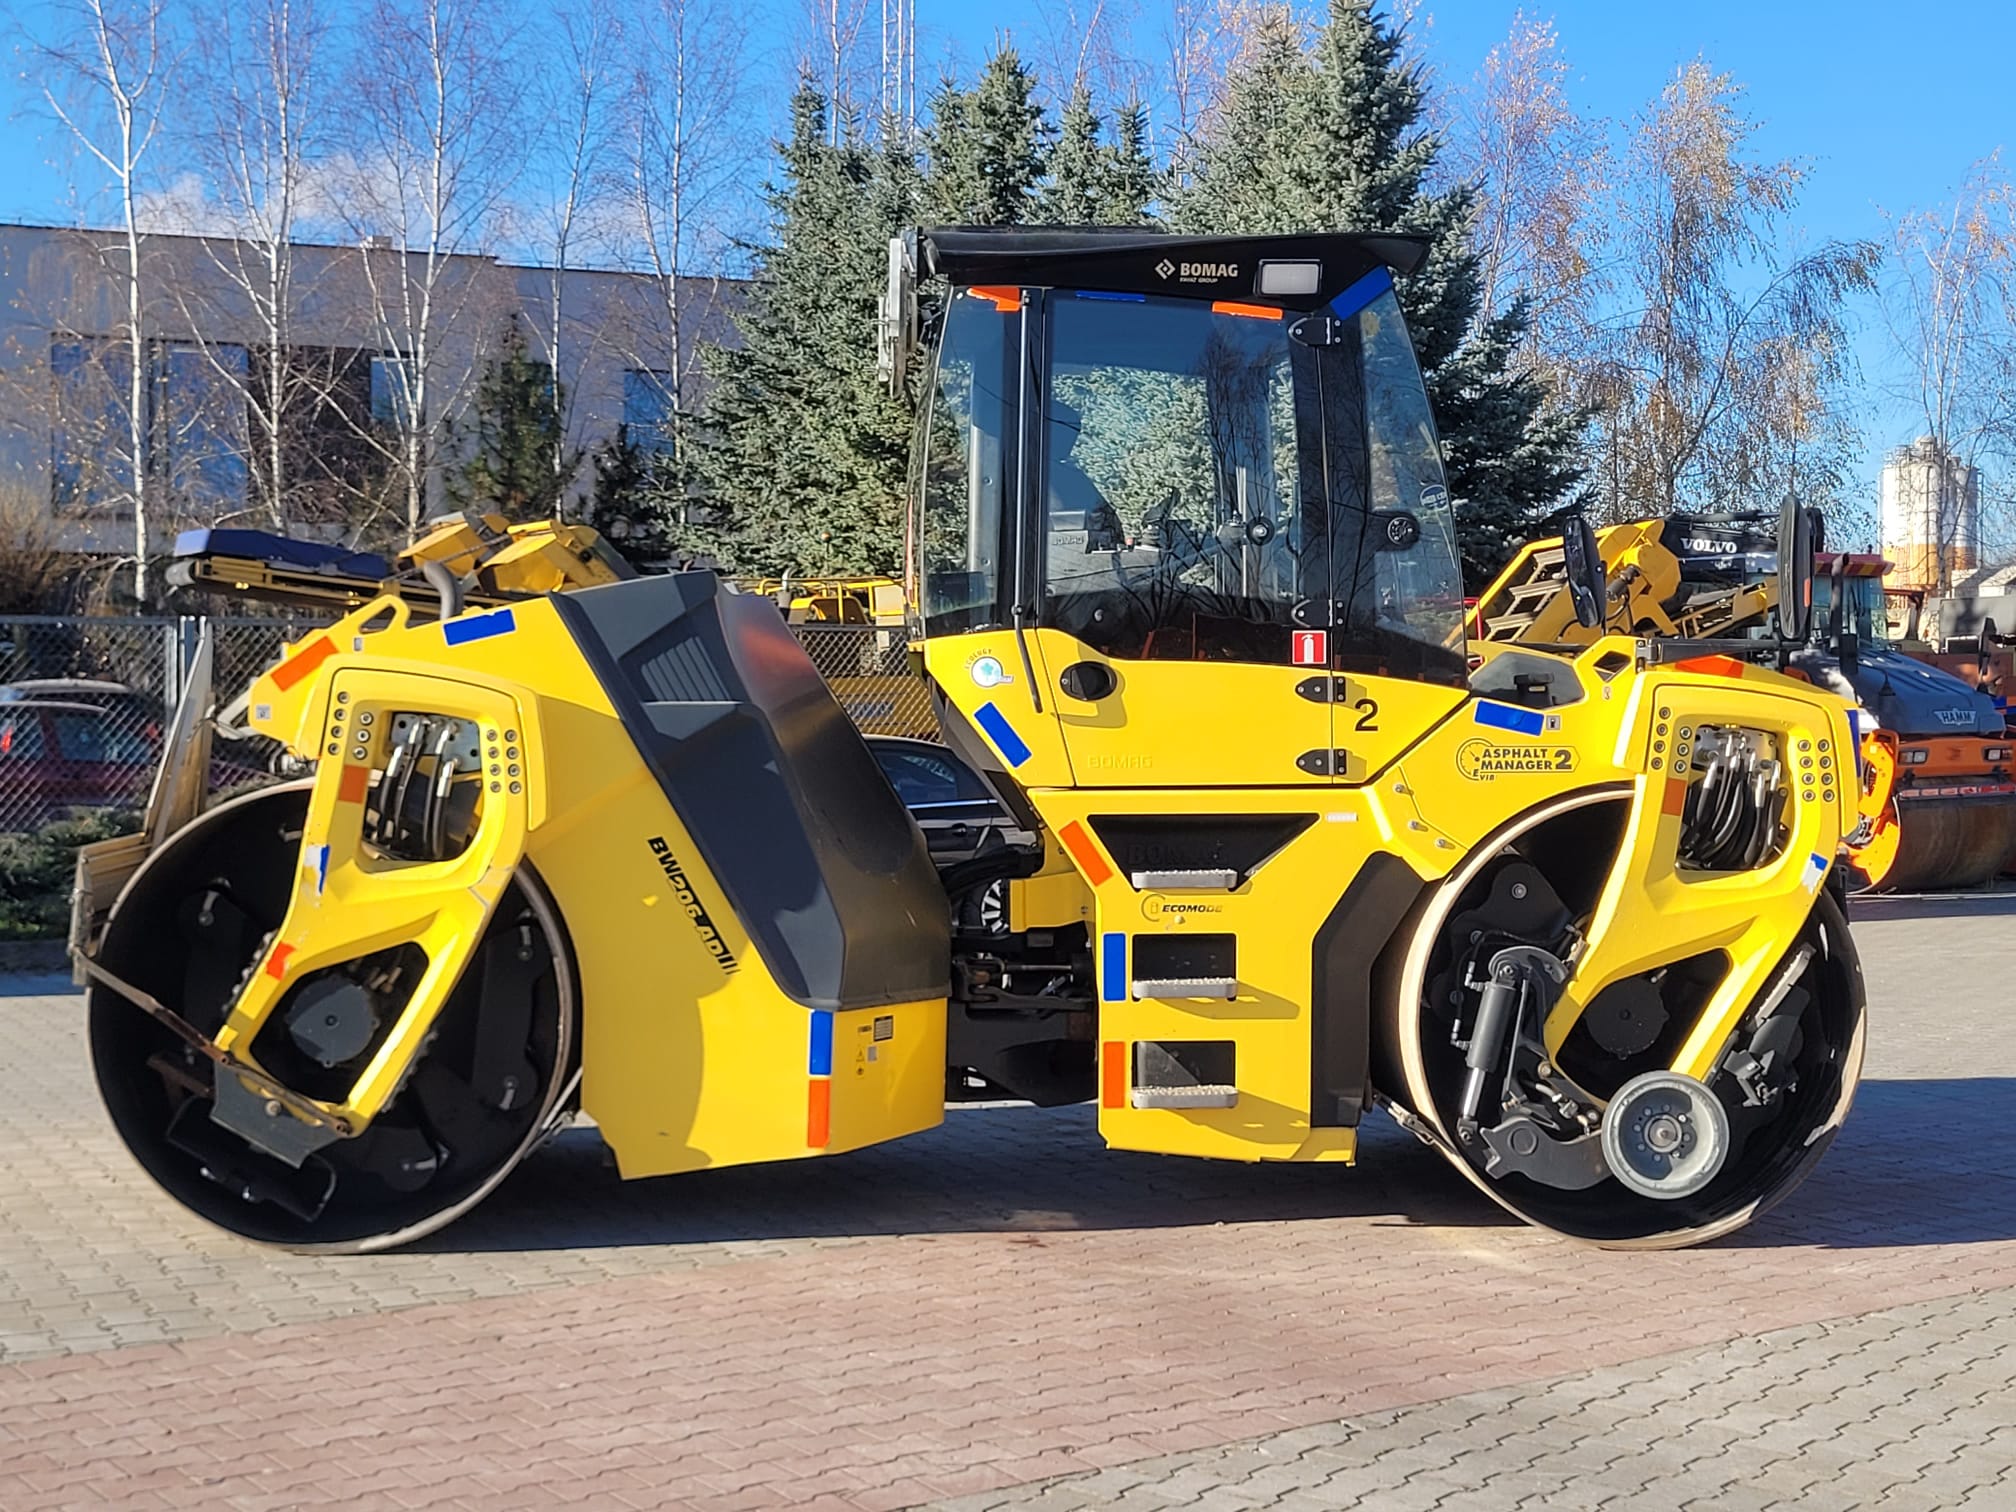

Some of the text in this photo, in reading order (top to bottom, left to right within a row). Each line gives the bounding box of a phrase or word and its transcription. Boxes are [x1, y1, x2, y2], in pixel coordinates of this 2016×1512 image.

[1180, 262, 1239, 277] BOMAG
[1680, 538, 1737, 553] VOLVO
[1355, 698, 1379, 731] 2
[1940, 710, 1972, 722] HAMM
[1482, 748, 1548, 759] ASPHALT
[1554, 750, 1573, 770] 2
[1087, 754, 1153, 769] BOMAG
[1480, 760, 1553, 771] MANAGER
